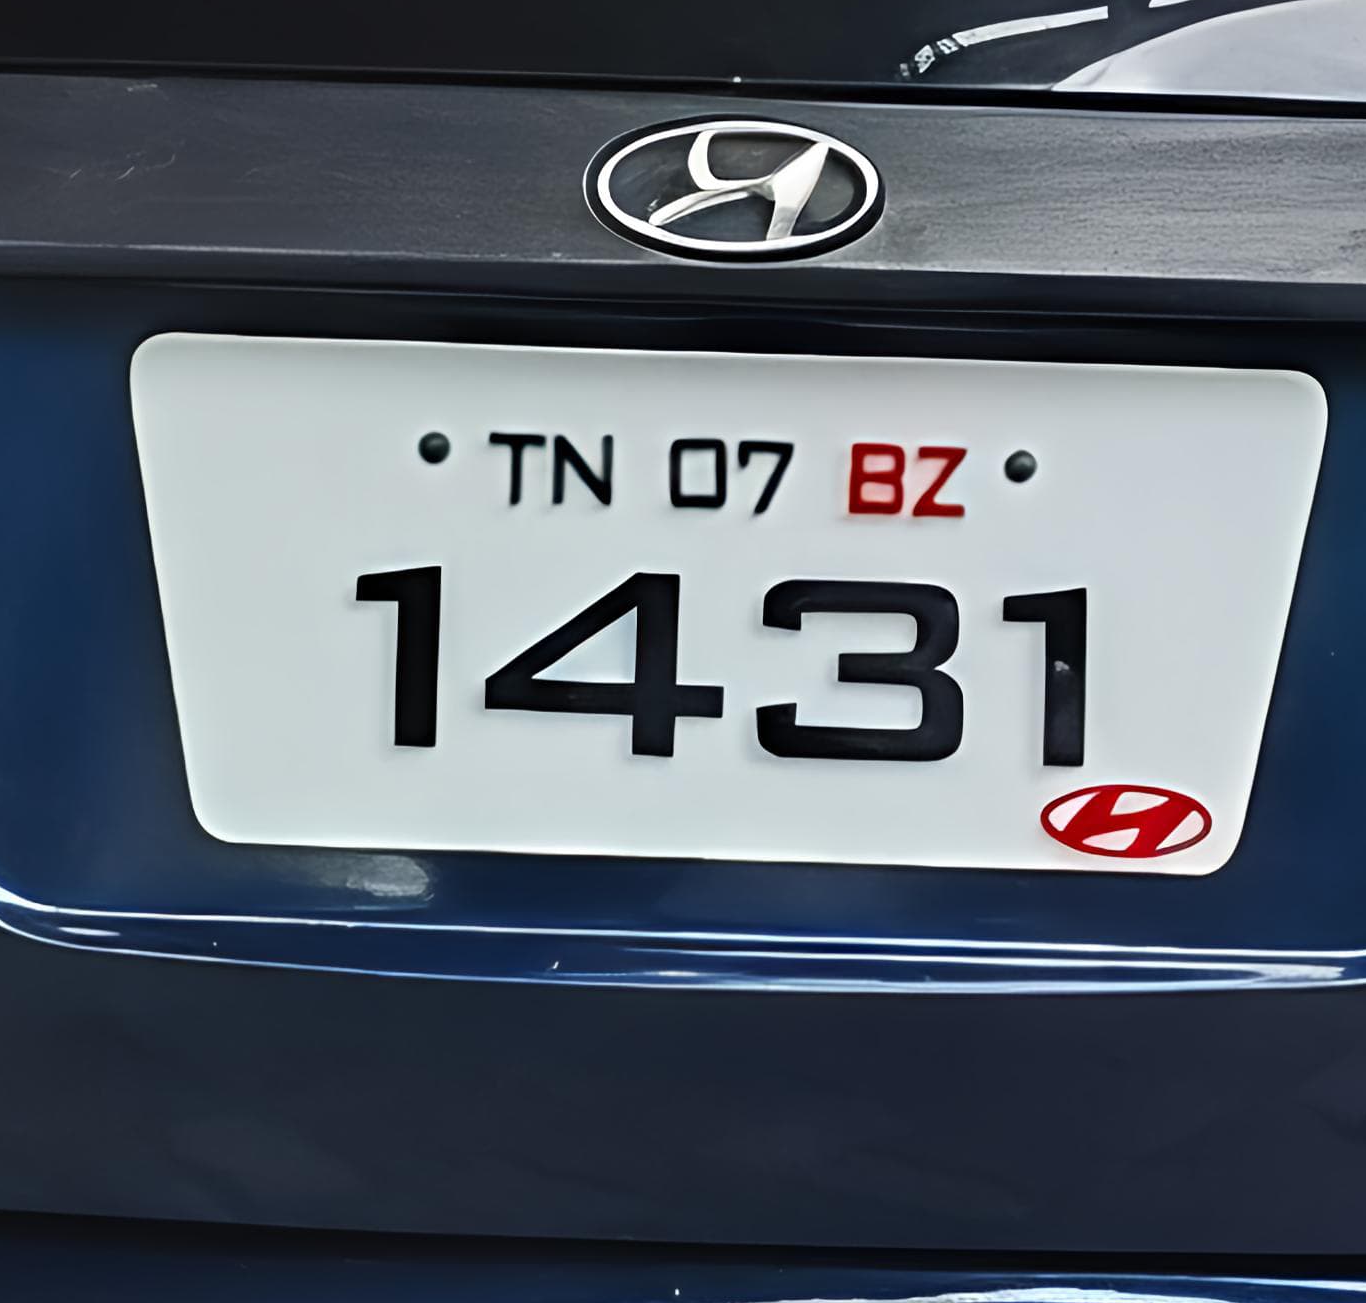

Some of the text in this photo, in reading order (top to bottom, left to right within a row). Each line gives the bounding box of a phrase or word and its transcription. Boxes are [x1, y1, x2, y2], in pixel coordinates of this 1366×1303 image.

[489, 433, 968, 518] TN 07 BZ
[355, 565, 1087, 767] 1431
